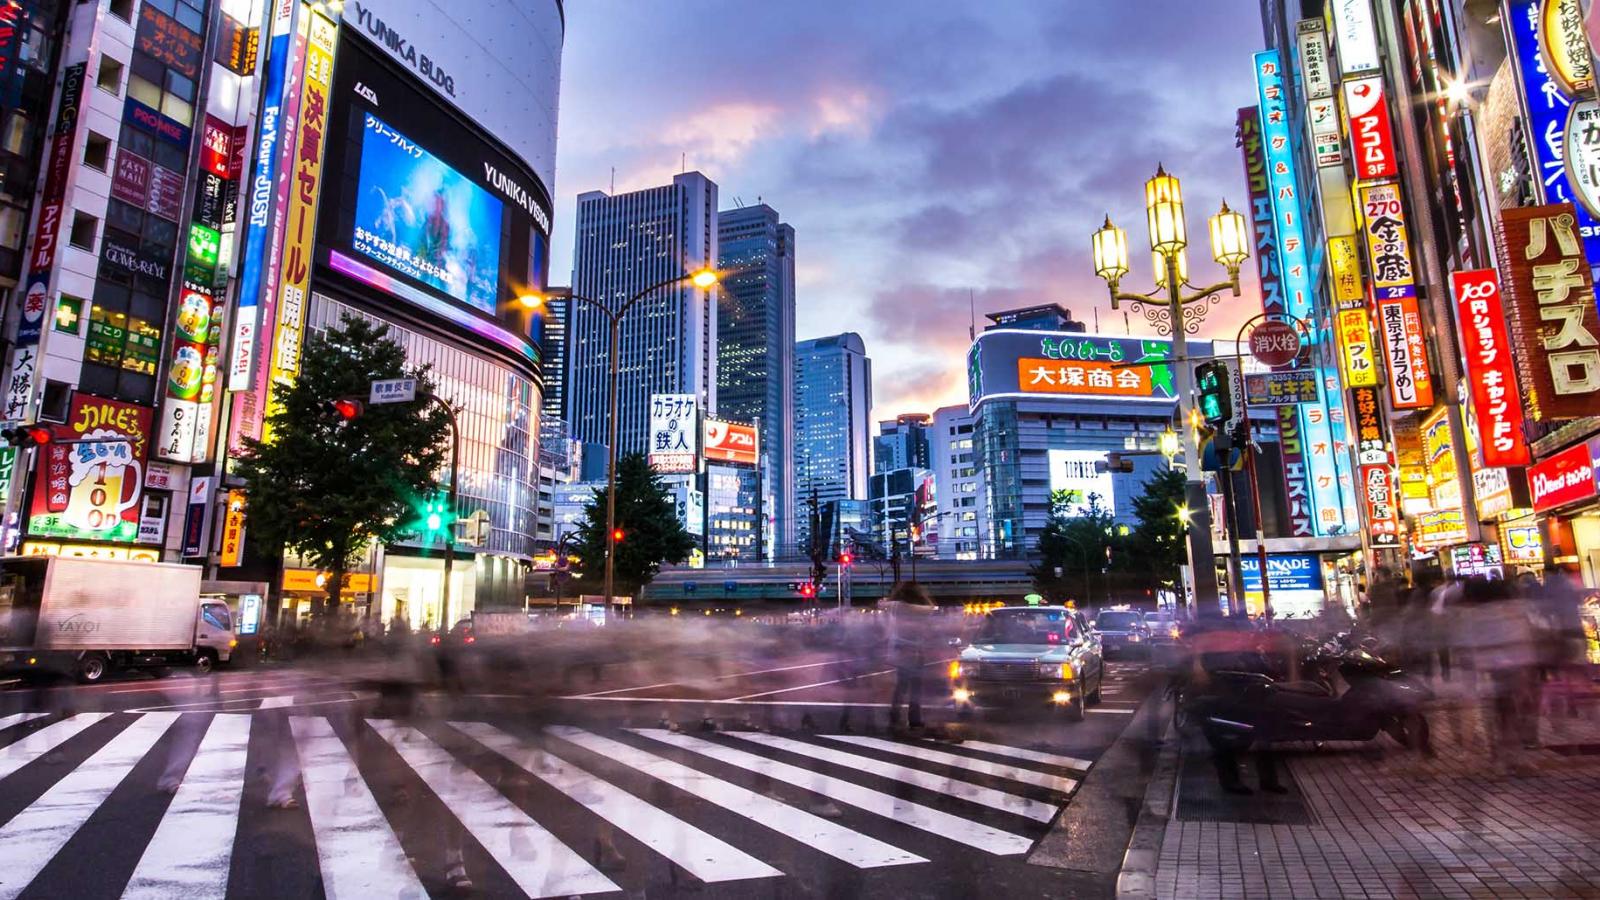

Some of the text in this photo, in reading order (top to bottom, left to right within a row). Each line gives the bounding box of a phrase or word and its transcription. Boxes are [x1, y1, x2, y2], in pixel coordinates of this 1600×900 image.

[355, 2, 457, 98] YUNIKA BLDG.
[133, 107, 183, 140] PROMISE
[1577, 109, 1600, 121] 新
[1359, 116, 1385, 162] アコム
[1367, 163, 1386, 175] 3F
[250, 175, 272, 228] JUST
[484, 162, 550, 236] YUNIKA VISION
[1367, 201, 1400, 217] 270
[36, 204, 59, 268] アイフル
[1370, 216, 1410, 281] 金の蔵
[1388, 288, 1407, 298] 2F
[1525, 213, 1600, 396] パチスロ
[1459, 281, 1497, 365] 100円ショップ
[1041, 338, 1125, 361] たのめーる
[1254, 333, 1297, 353] 消火栓
[1384, 305, 1413, 402] 東京チカラめし
[239, 340, 251, 374] LABI
[6, 350, 33, 418] 大勝軒
[1029, 366, 1142, 389] 大塚商会
[653, 397, 694, 418] カラオケ
[668, 418, 678, 431] の
[656, 431, 689, 450] 鉄人
[729, 431, 754, 446] アコム
[1065, 460, 1100, 478] TIPNES
[1240, 558, 1311, 571] SUNADE
